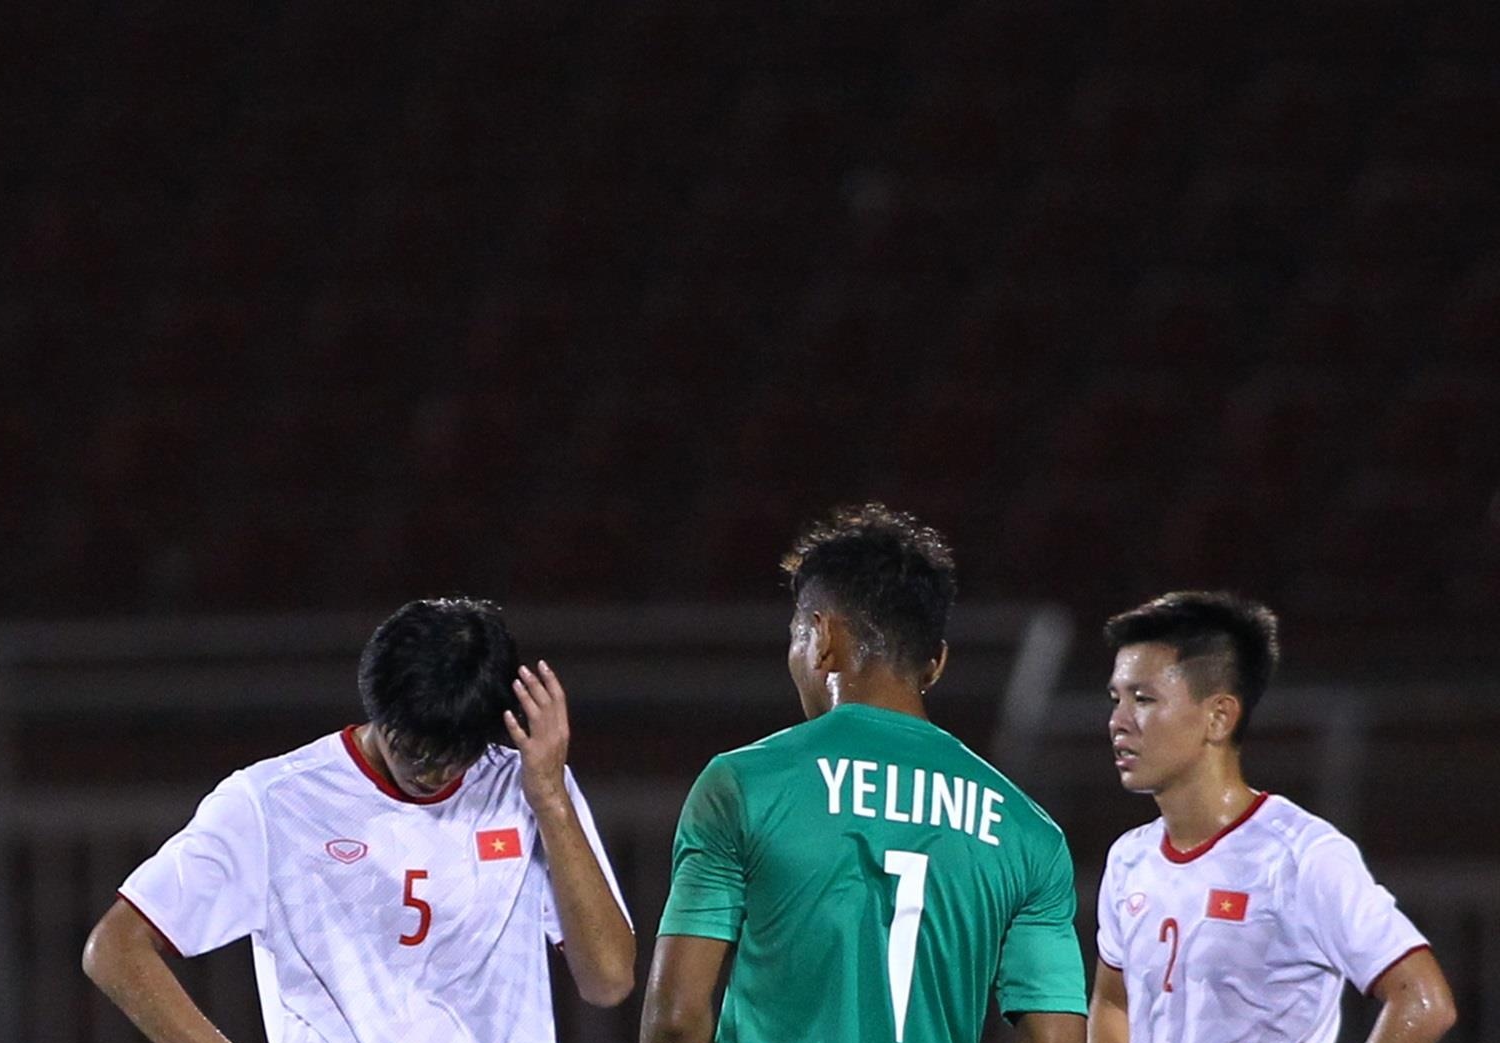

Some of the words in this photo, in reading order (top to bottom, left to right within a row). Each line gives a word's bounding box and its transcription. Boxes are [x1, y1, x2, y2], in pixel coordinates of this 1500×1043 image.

[816, 757, 1005, 846] YELINIE
[399, 868, 433, 947] 5
[883, 849, 929, 1043] 1
[1159, 916, 1181, 993] 2
